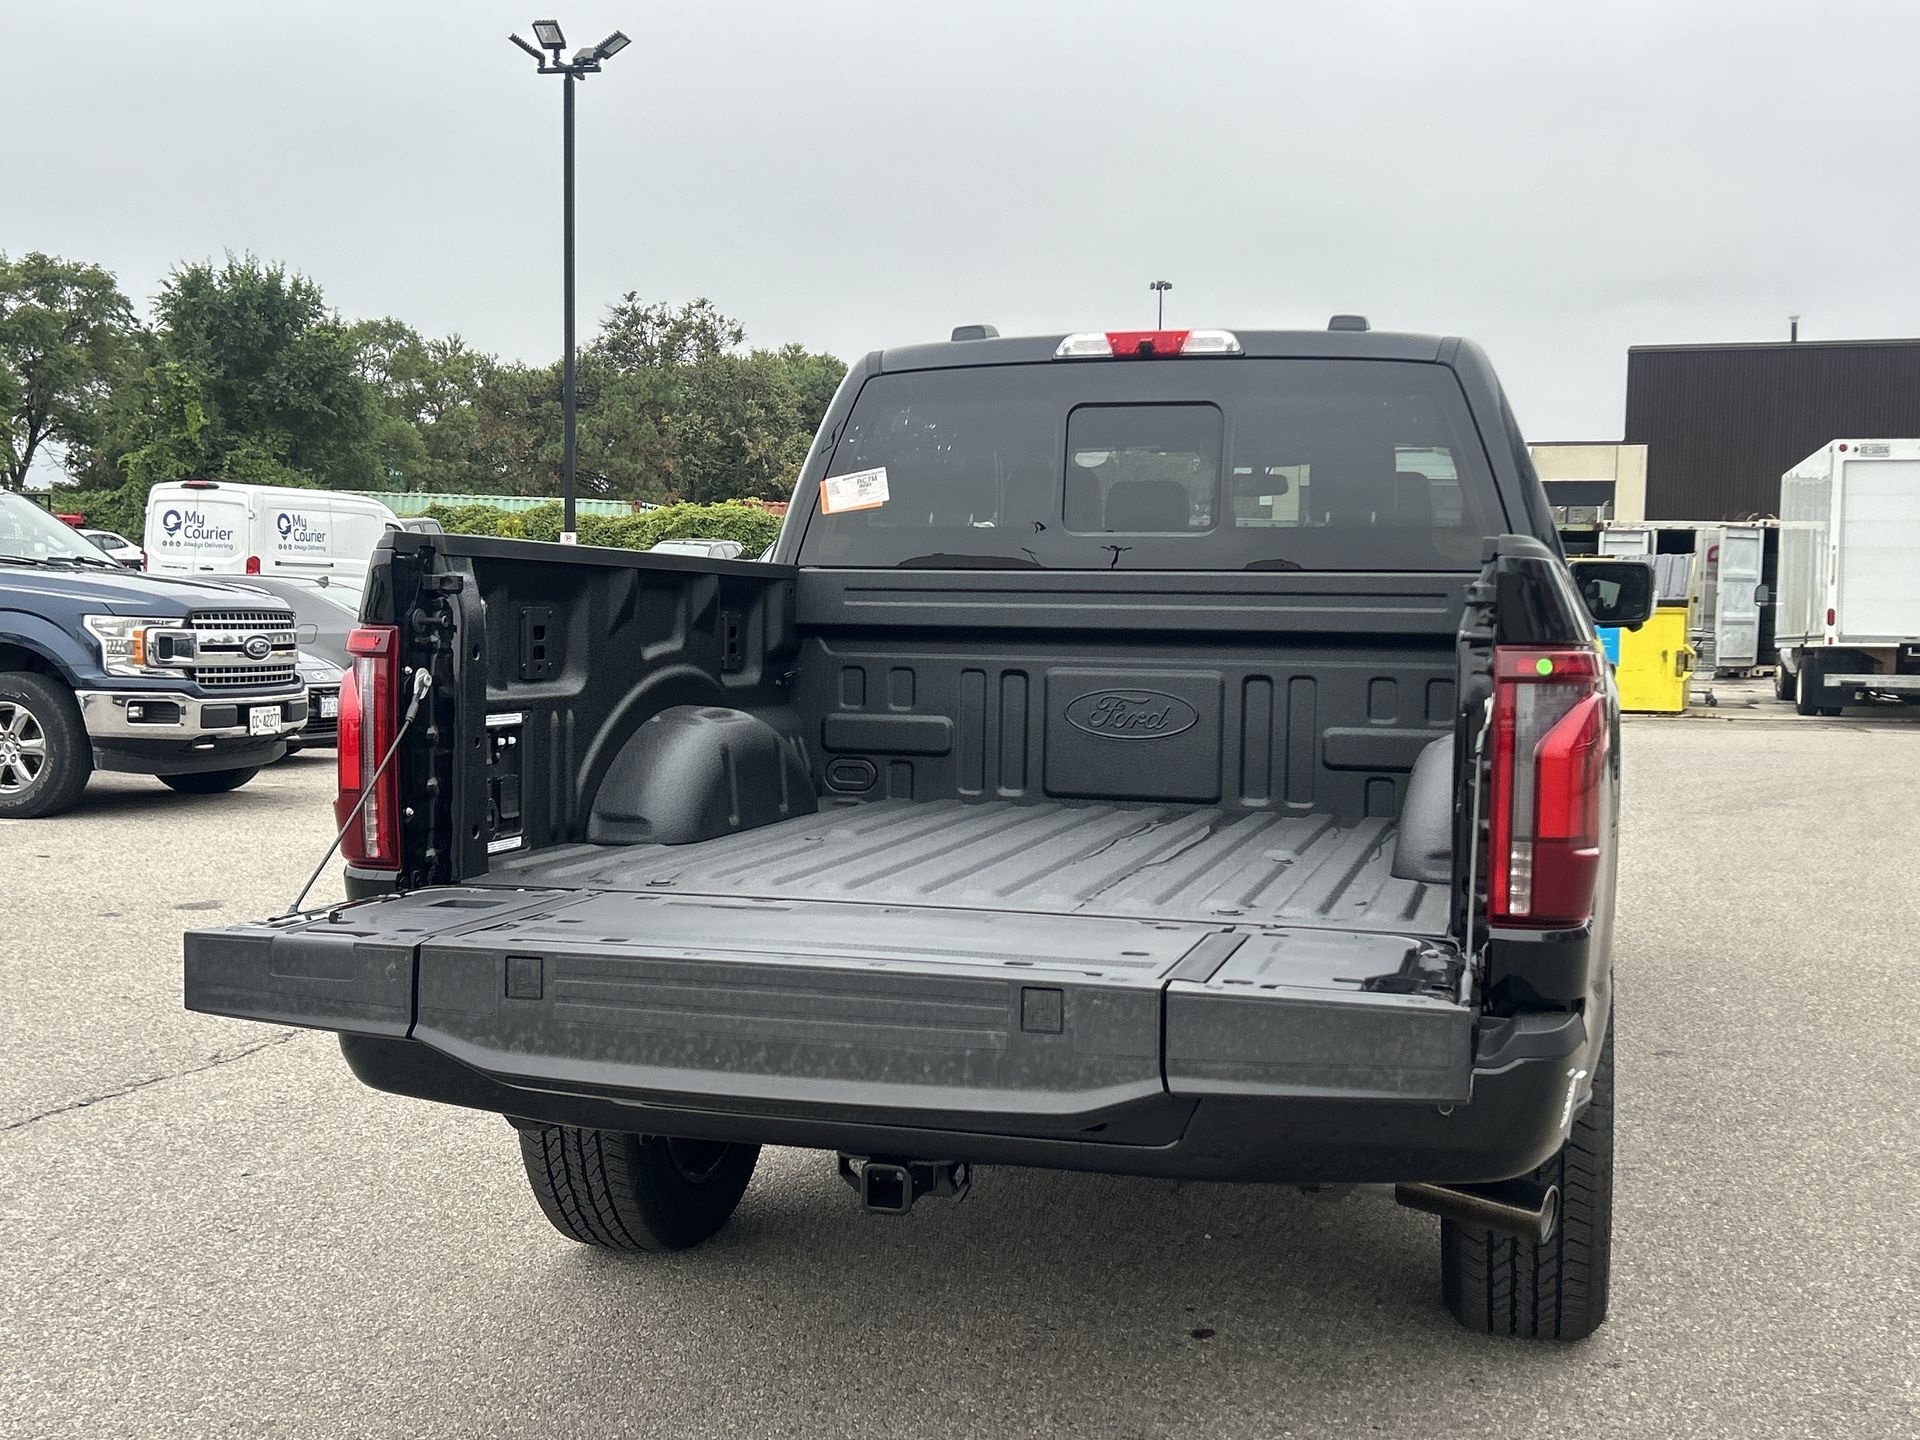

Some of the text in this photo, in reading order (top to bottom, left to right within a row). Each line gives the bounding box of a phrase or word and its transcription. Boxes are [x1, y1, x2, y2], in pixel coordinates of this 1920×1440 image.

[184, 510, 205, 528] My
[292, 514, 307, 531] My
[184, 525, 234, 540] Courier
[293, 528, 326, 543] Courier
[184, 541, 234, 550] Always Delivering
[1088, 695, 1171, 730] Ford
